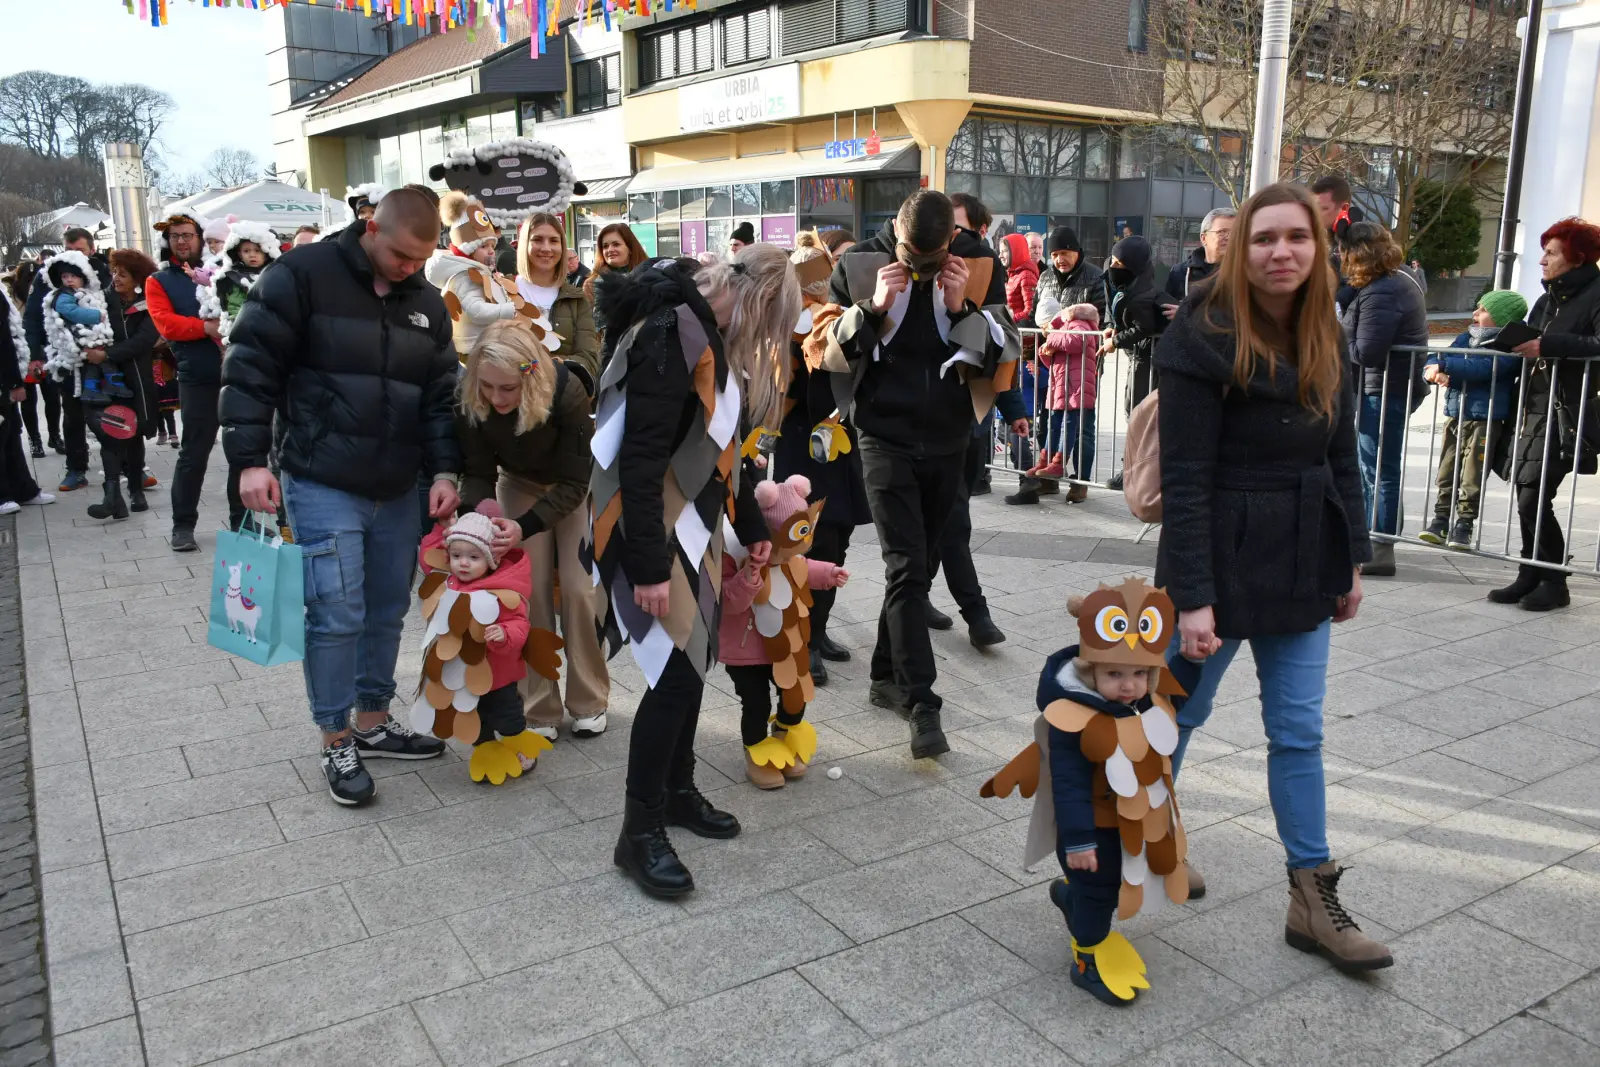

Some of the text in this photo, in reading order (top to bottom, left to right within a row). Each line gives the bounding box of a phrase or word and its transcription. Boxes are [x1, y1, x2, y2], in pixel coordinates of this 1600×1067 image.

[724, 76, 760, 97] URBIA
[690, 108, 714, 127] urbi
[718, 106, 731, 123] et
[767, 96, 785, 115] 25
[825, 138, 866, 159] ERSTE
[264, 203, 323, 212] PAN
